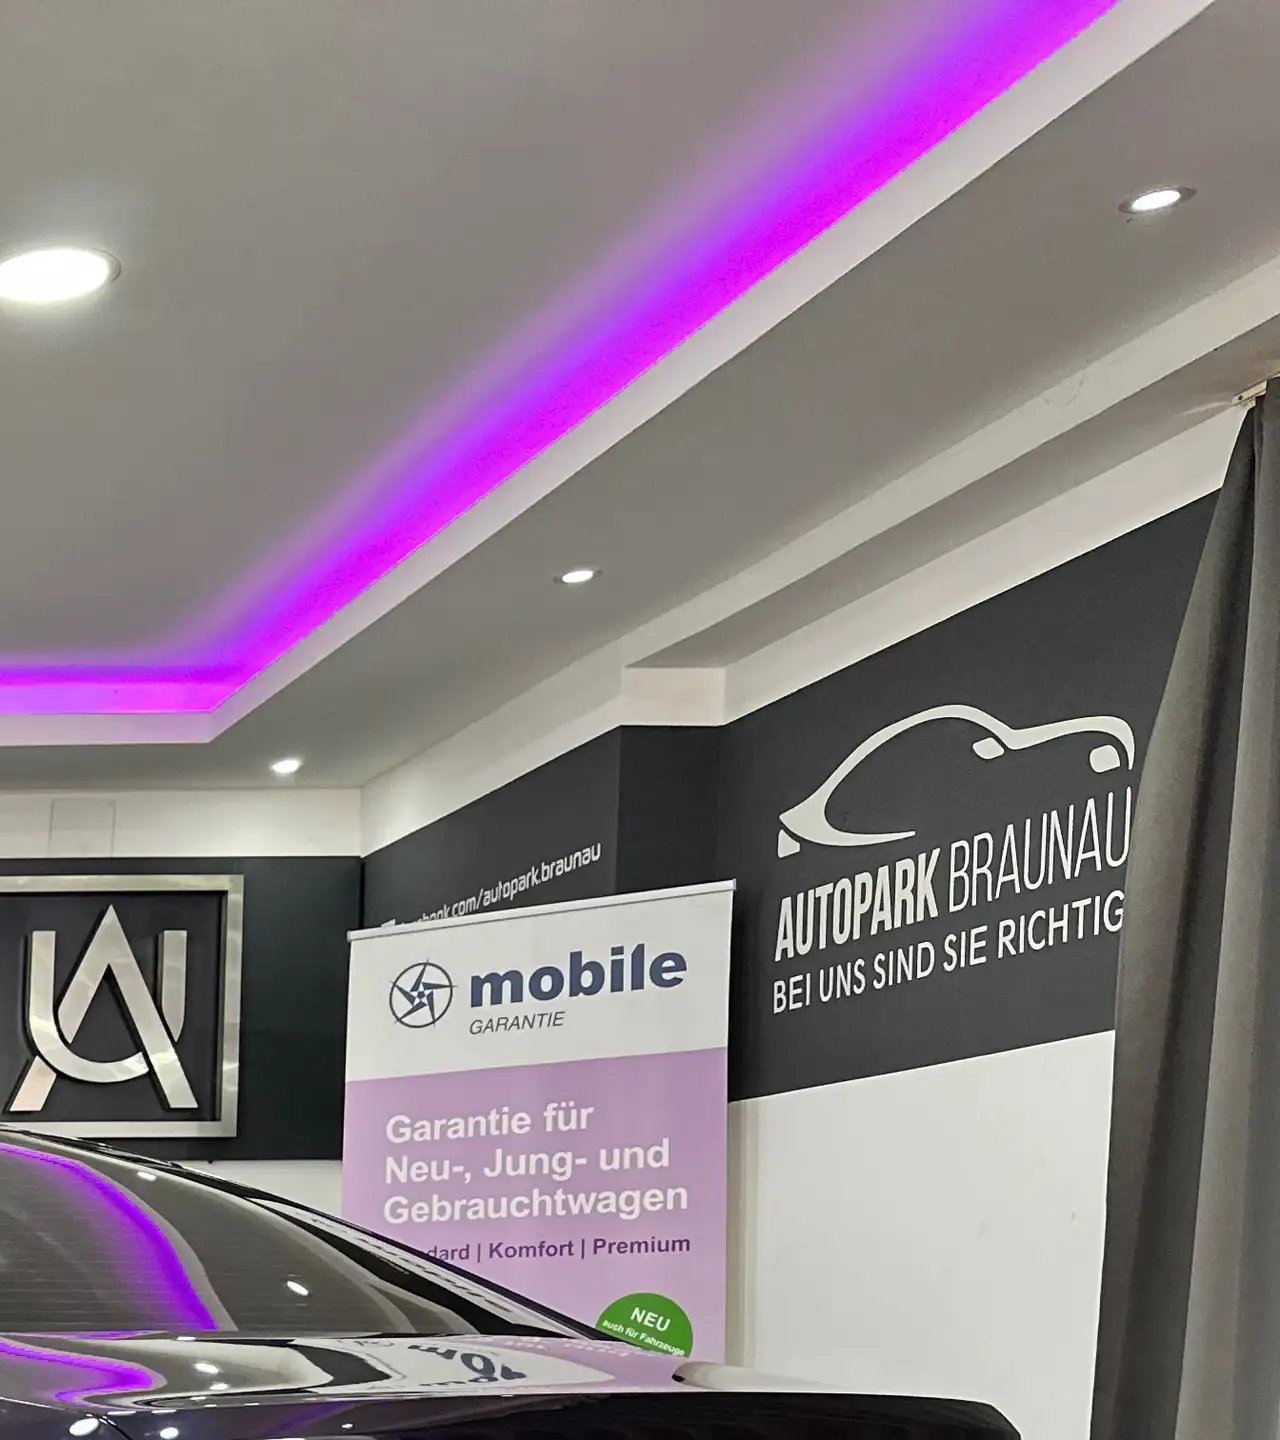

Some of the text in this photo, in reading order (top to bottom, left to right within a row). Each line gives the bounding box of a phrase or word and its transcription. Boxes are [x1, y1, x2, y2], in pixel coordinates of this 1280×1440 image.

[774, 786, 1132, 962] AUTOPARK BRAUNAU
[773, 890, 1125, 1015] BEI UNS SIND SIE RICHTIG
[470, 943, 687, 1007] mobile
[469, 1011, 566, 1035] GARANTIE
[385, 1101, 595, 1144] Garantie für
[384, 1138, 670, 1184] Neu-, Jung- und
[384, 1186, 688, 1224] Gebrauchtwagen
[488, 1238, 574, 1260] Komfort
[592, 1236, 691, 1256] Premium
[601, 1319, 686, 1357] auch für Fahrzeuge
[630, 1305, 671, 1332] NEU
